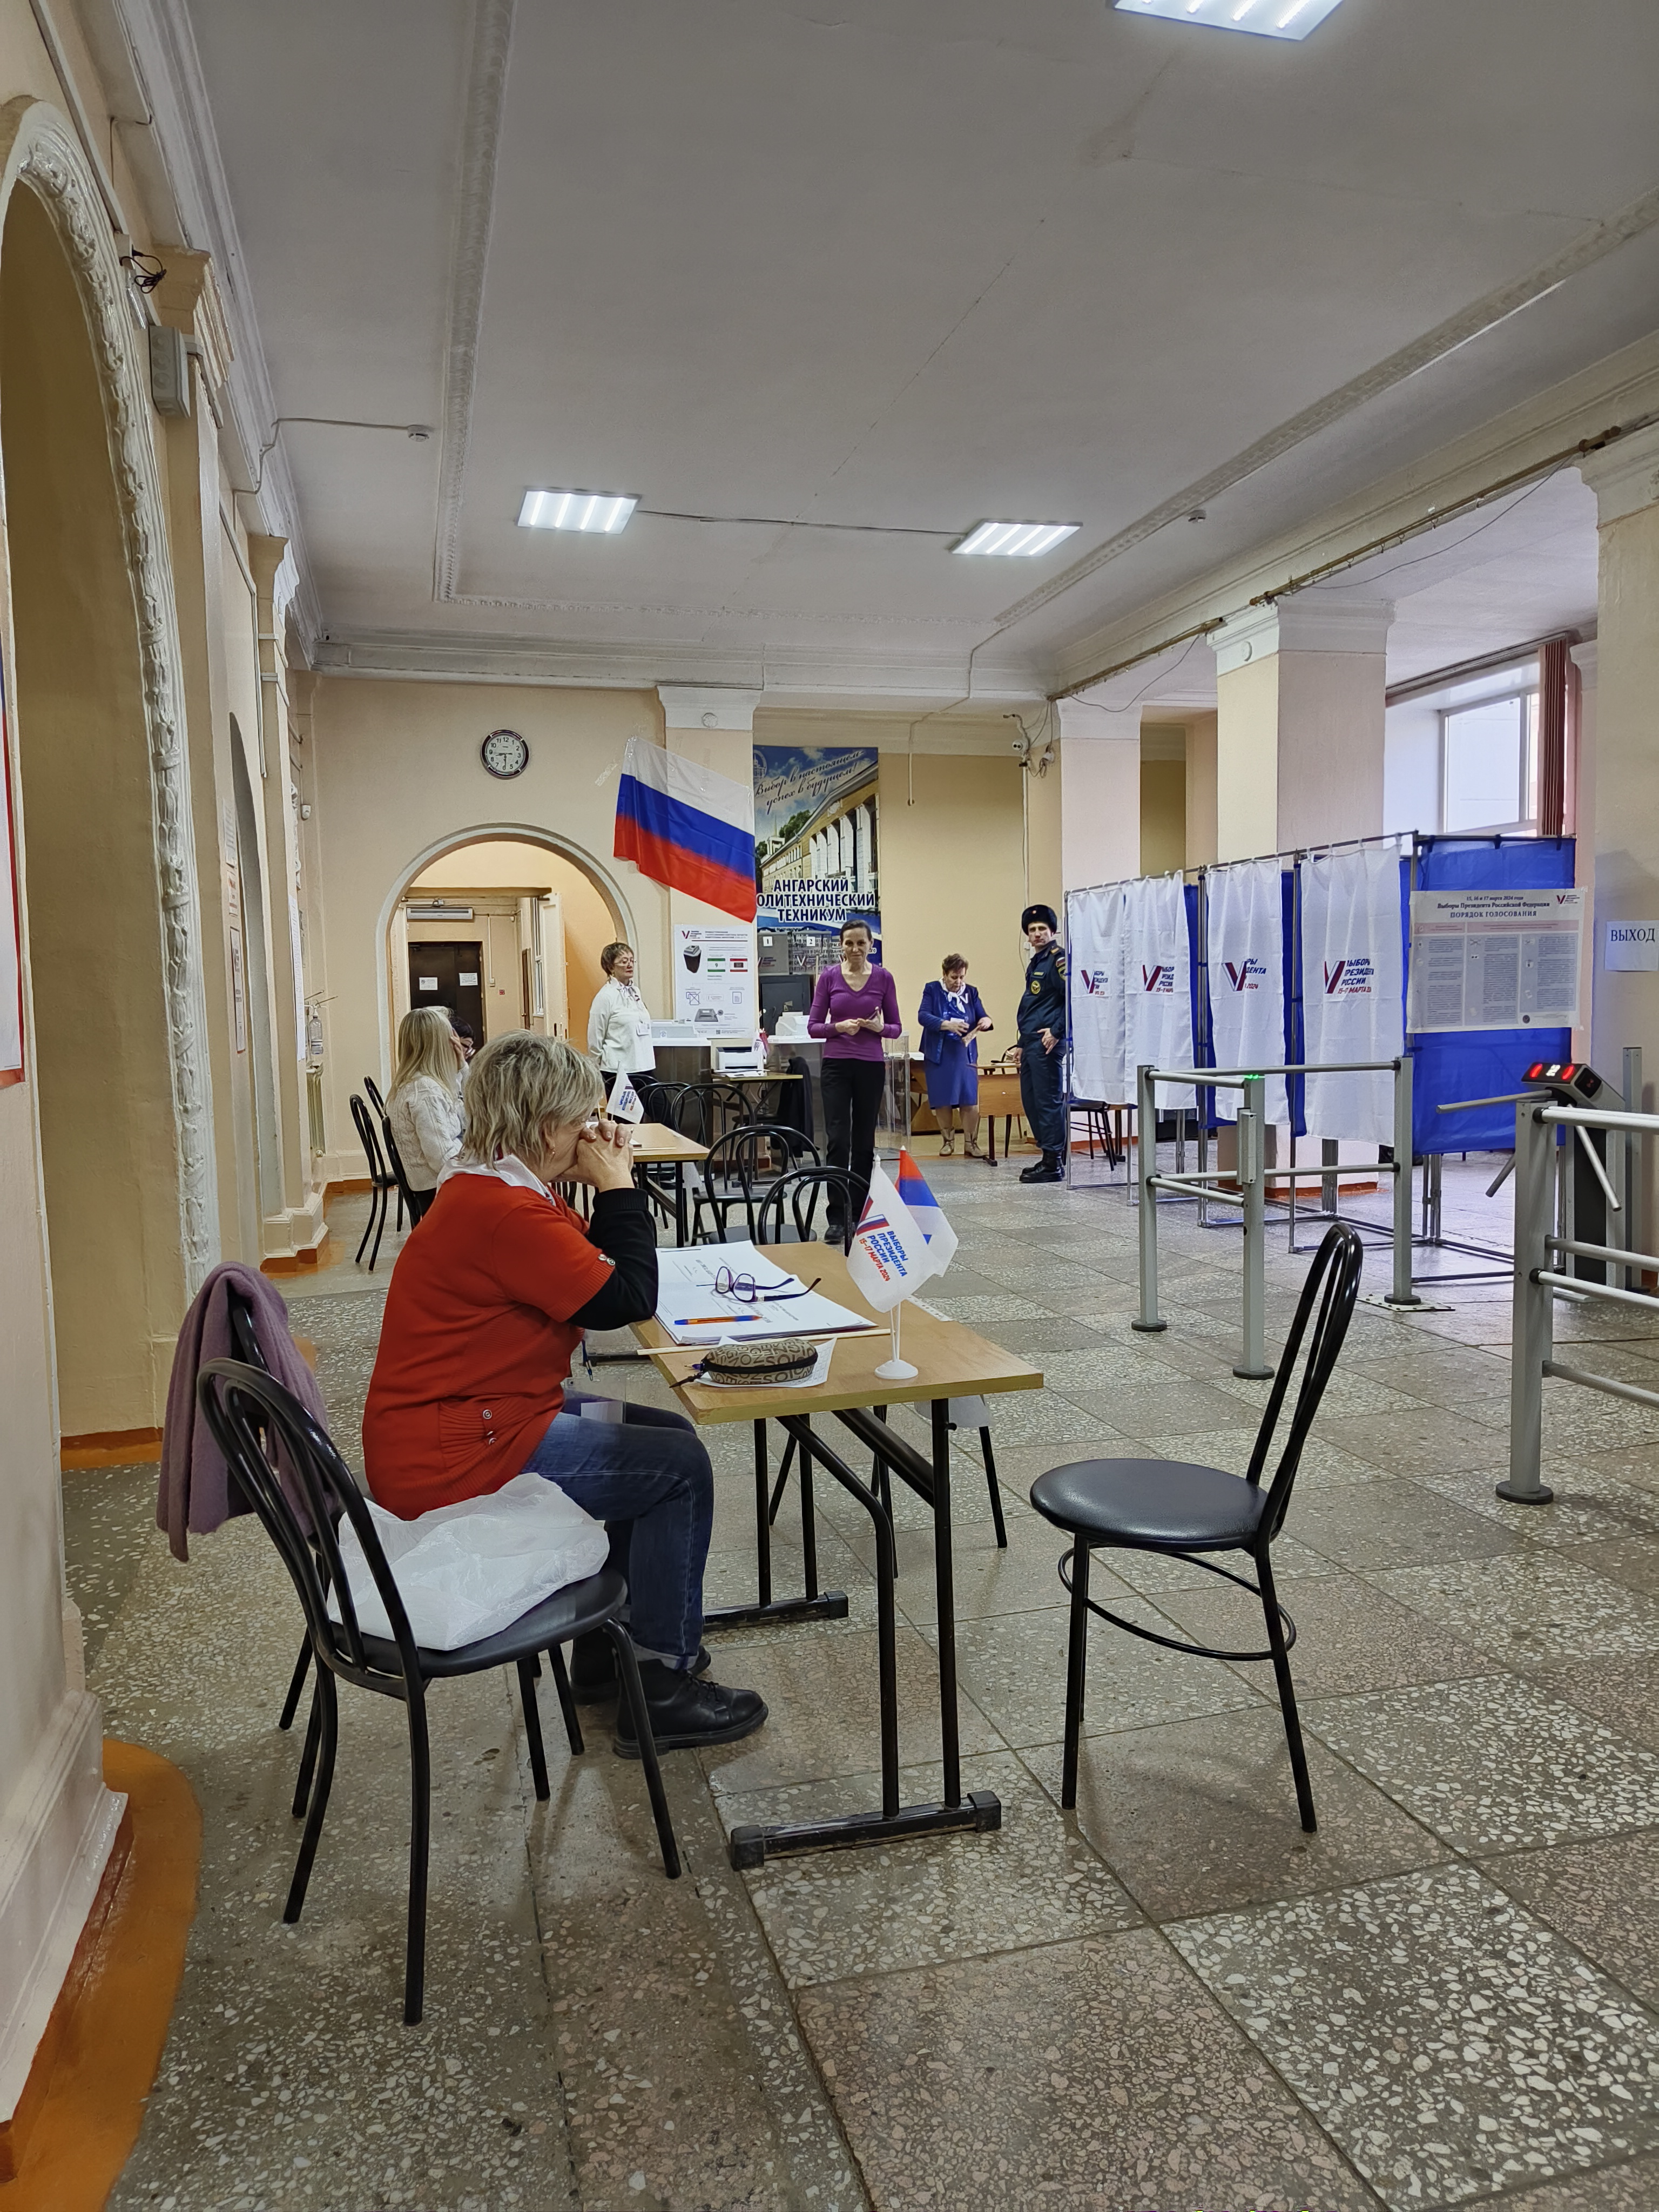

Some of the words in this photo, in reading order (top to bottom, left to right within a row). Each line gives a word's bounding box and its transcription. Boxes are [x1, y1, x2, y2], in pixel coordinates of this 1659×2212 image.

[756, 777, 787, 797] Выбор
[790, 766, 798, 783] в
[767, 791, 795, 815] успех
[798, 778, 805, 794] в
[807, 763, 857, 797] будущем!
[774, 877, 848, 892] АНГАРСКИЙ
[757, 892, 874, 907] ОЛИТЕХНИЧЕСКИЙ
[778, 909, 846, 921] ТЕХНИКУМ
[1611, 928, 1655, 943] ВЫХОД
[867, 1235, 889, 1263] РОССИИ
[877, 1233, 907, 1277] ПРЕЗИДЕНТА
[887, 1231, 908, 1261] ВЫБОРЫ
[868, 1251, 884, 1269] МАРТА
[880, 1269, 891, 1282] 2024
